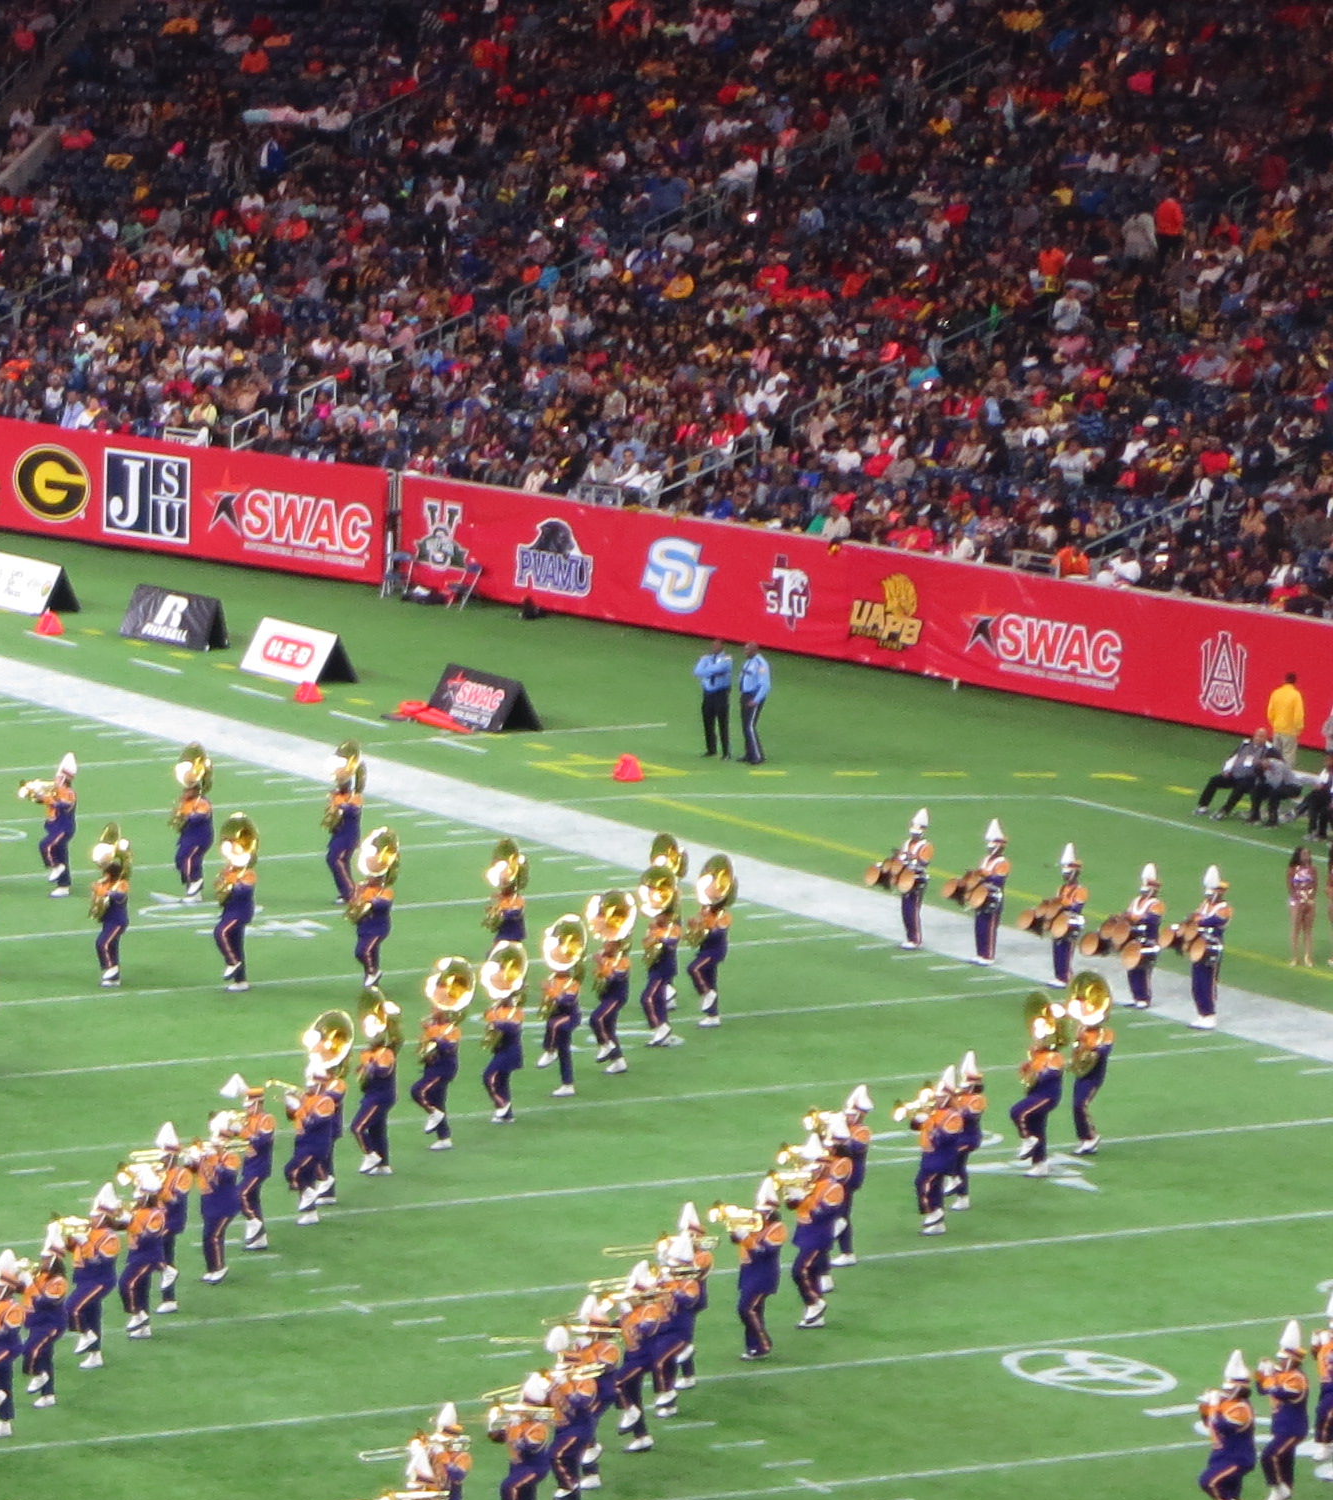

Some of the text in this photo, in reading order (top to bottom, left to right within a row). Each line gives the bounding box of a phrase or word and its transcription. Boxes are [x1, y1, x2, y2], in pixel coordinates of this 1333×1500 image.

[242, 488, 373, 555] SWAC
[516, 548, 592, 597] PVAMU
[141, 622, 188, 644] RUSSELL
[849, 600, 924, 646] UAPB
[997, 613, 1123, 678] SWAC
[456, 680, 506, 711] SWAC
